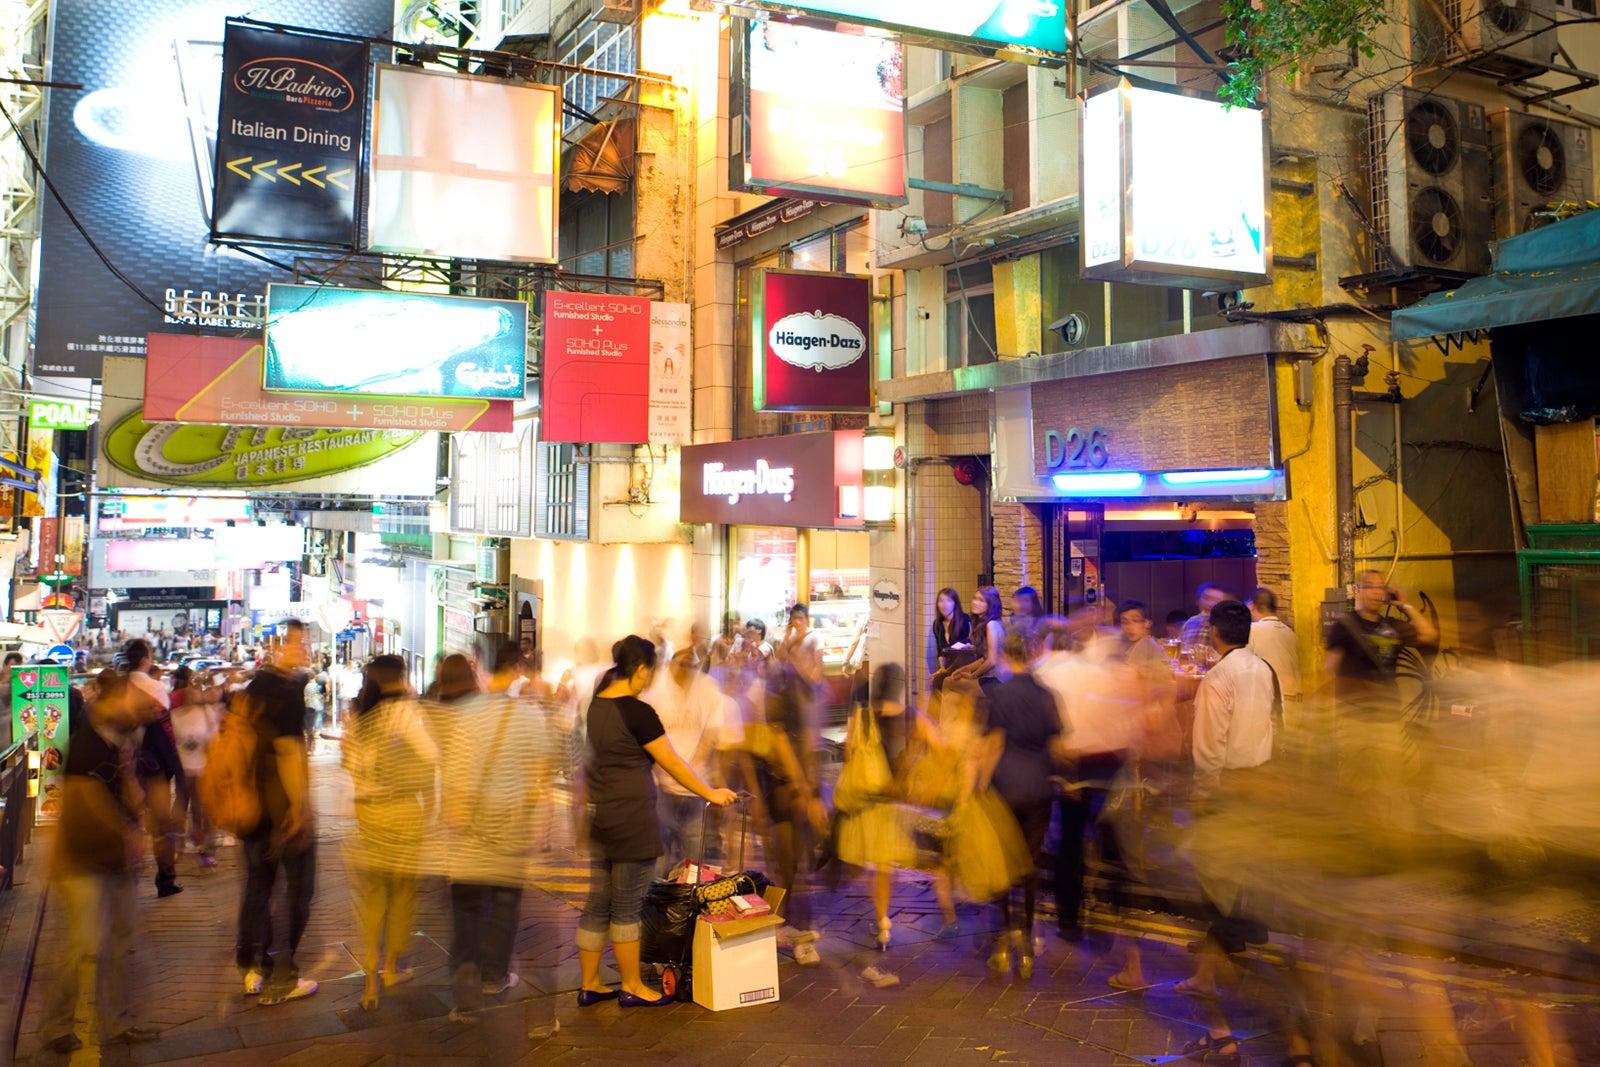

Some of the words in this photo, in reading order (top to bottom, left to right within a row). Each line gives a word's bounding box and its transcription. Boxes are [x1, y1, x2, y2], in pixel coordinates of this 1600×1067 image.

[265, 67, 343, 98] Padrino
[231, 119, 287, 141] Italian
[293, 126, 351, 151] Dining
[1141, 233, 1196, 260] D26
[553, 299, 606, 312] Excellent
[608, 303, 642, 314] SOHO
[199, 317, 228, 327] LABEL
[553, 310, 589, 320] Furnished
[590, 312, 614, 321] Studio
[566, 338, 600, 349] SOHO
[603, 338, 628, 351] Plus
[566, 347, 600, 356] Furnished
[601, 348, 623, 357] Studio
[221, 397, 290, 411] Excellent
[293, 398, 337, 413] SOHO
[373, 404, 419, 418] SOHO
[421, 405, 454, 420] Plus
[221, 410, 270, 422] Furnished
[271, 412, 301, 422] Studio
[373, 416, 419, 426] Furnished
[420, 417, 447, 427] Studio
[234, 444, 296, 466] JAPANESE
[298, 431, 377, 455] RESTAURANT
[1044, 426, 1109, 468] D26
